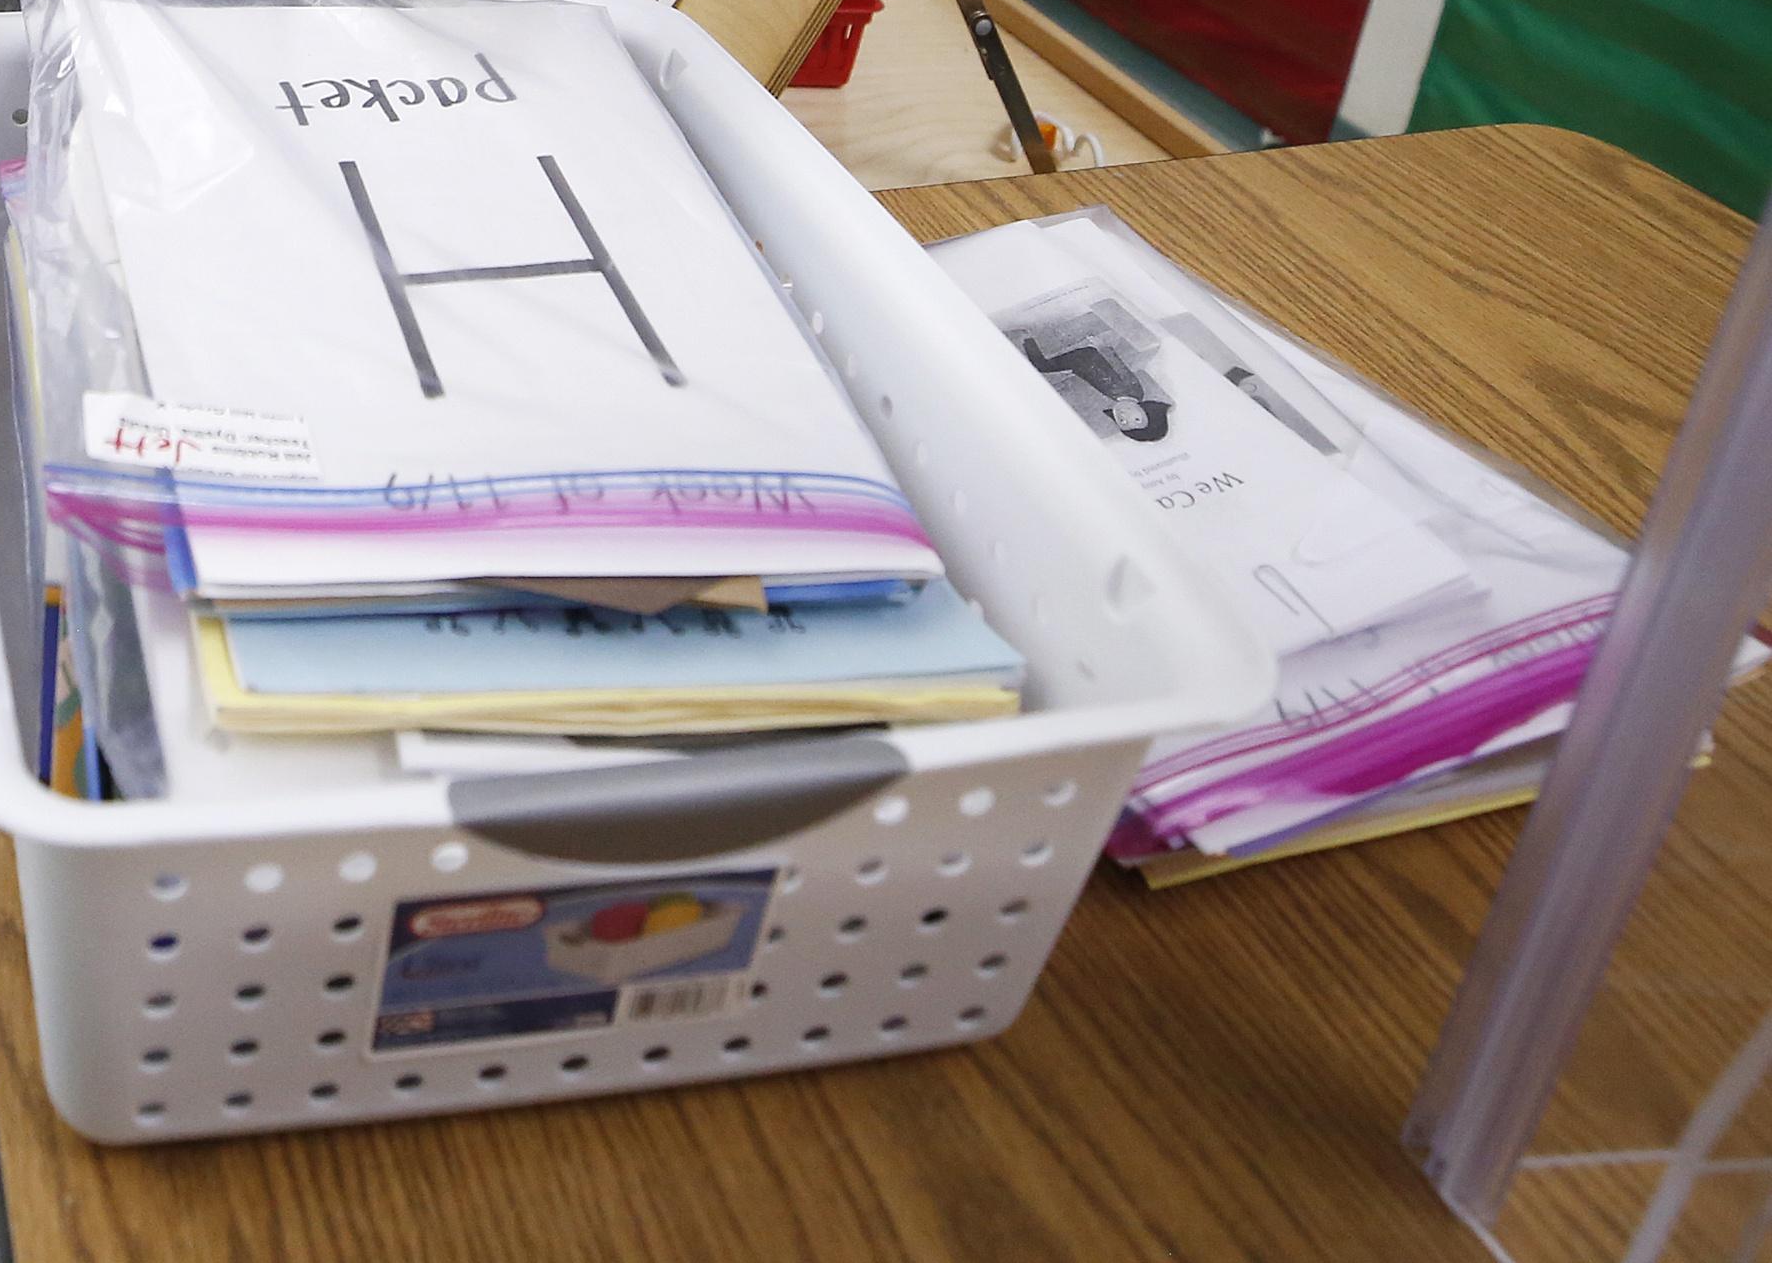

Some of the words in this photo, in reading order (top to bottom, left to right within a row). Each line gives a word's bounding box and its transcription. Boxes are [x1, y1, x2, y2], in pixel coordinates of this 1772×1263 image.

[275, 52, 518, 127] packet
[338, 154, 688, 399] H
[104, 426, 203, 464] Jett
[1193, 472, 1245, 494] We
